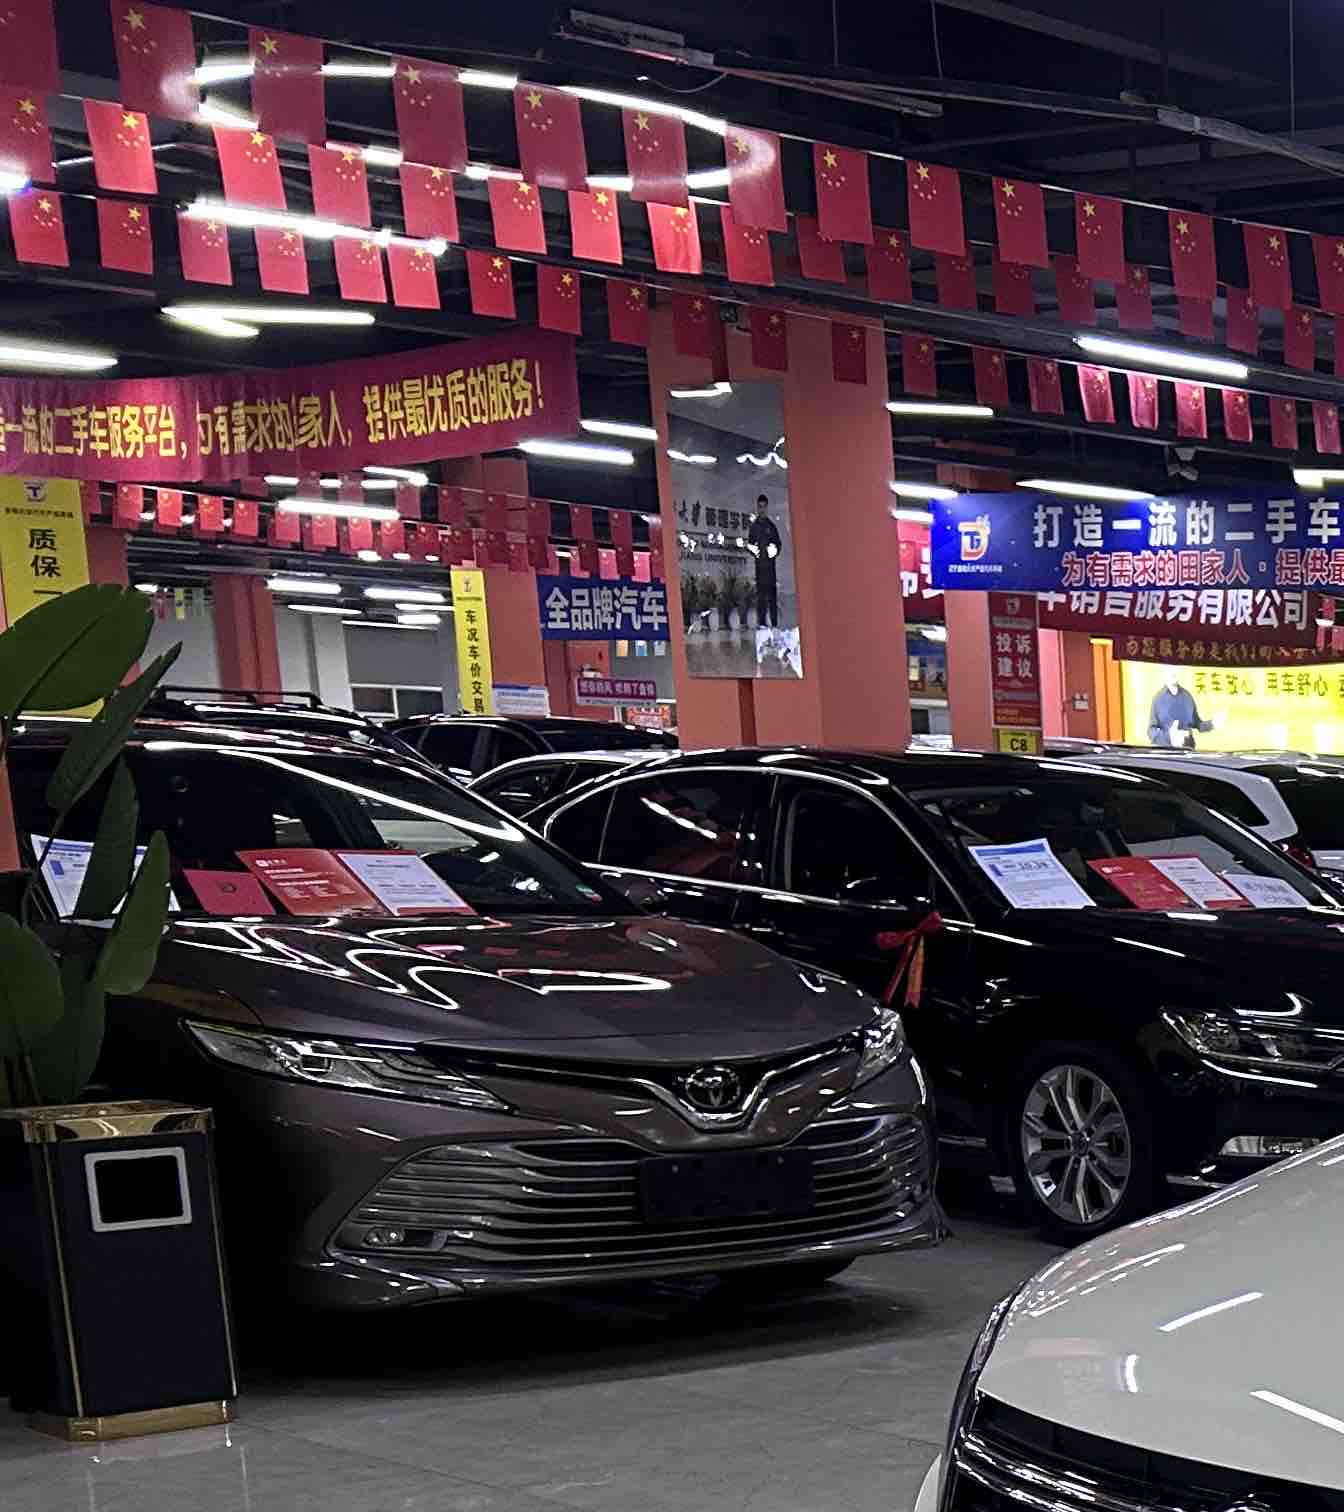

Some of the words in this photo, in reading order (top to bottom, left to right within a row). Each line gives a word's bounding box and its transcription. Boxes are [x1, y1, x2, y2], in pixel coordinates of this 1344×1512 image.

[546, 586, 668, 631] 全品牌汽车
